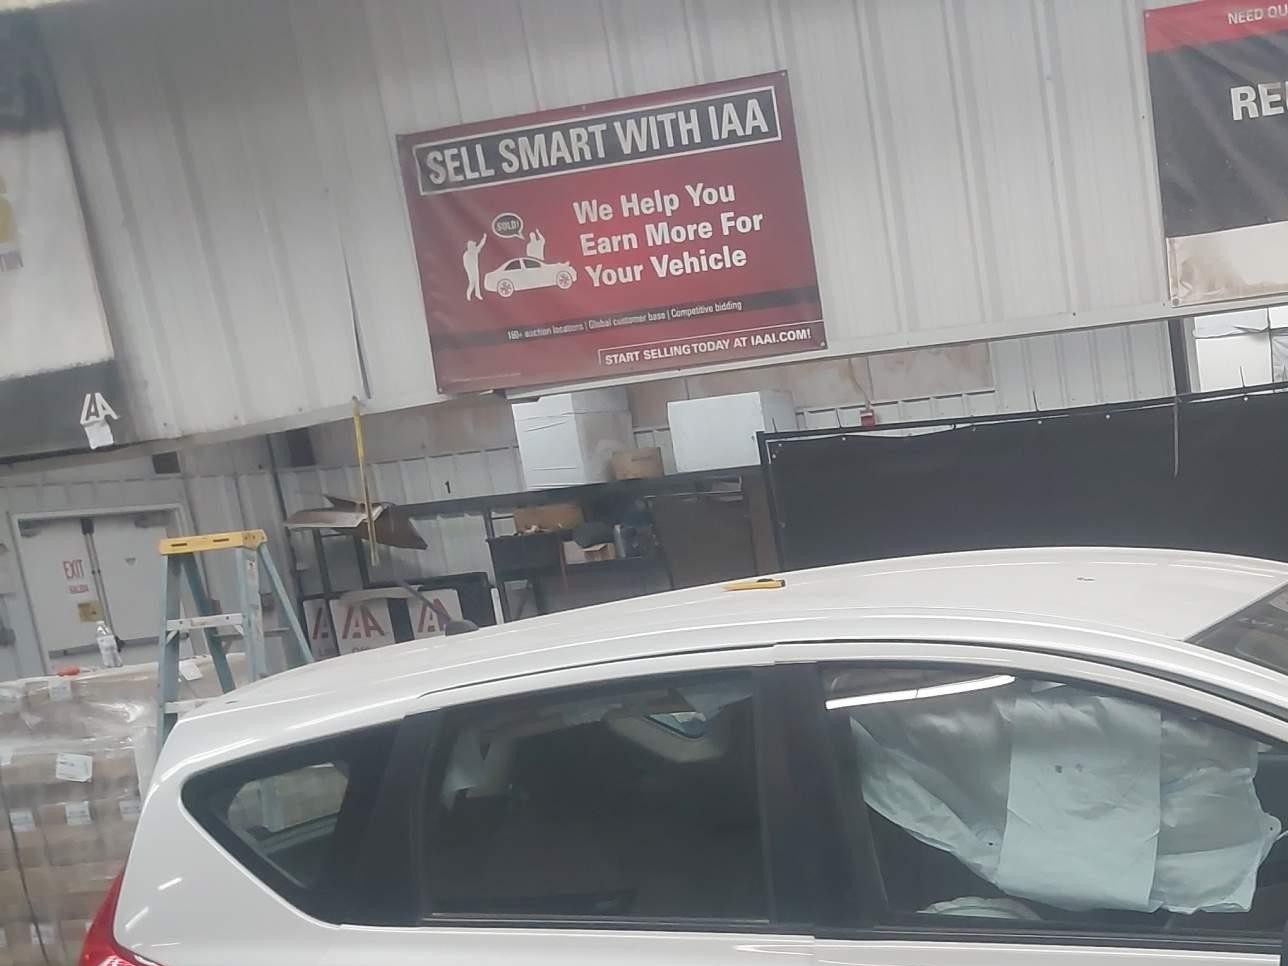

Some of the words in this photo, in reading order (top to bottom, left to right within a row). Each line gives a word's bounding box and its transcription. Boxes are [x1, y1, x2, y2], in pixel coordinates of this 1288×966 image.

[1227, 8, 1264, 25] NEED
[426, 143, 495, 185] SELL
[498, 123, 607, 174] SMART
[613, 108, 702, 155] WITH
[708, 98, 769, 141] IAA
[572, 198, 613, 225] We
[620, 188, 680, 218] Help
[685, 182, 736, 207] You
[579, 231, 639, 257] Earn
[645, 221, 713, 247] More
[720, 211, 764, 236] For
[585, 263, 644, 288] Your
[650, 245, 748, 278] Vehicle
[524, 327, 552, 338] auction
[588, 318, 612, 330] Global
[647, 311, 666, 321] base
[671, 304, 714, 319] Competitive
[714, 300, 743, 312] bidding
[605, 351, 641, 366] START
[643, 345, 691, 360] SELLING
[691, 338, 731, 354] TODAY
[733, 336, 748, 348] AT
[751, 327, 812, 347] IAAI.COM!
[63, 559, 85, 579] EXIT
